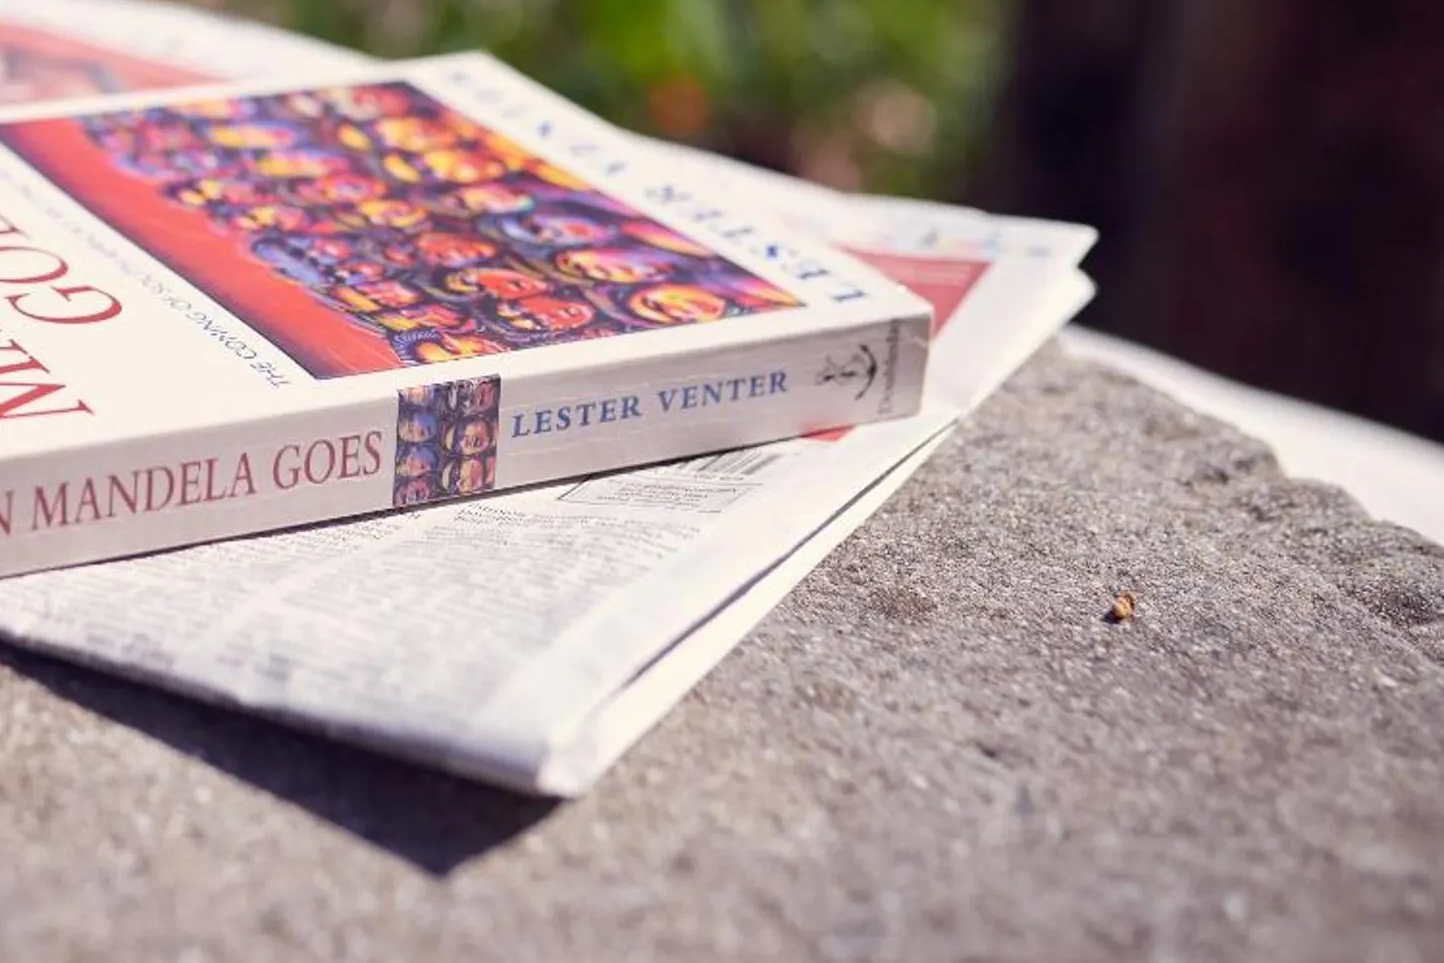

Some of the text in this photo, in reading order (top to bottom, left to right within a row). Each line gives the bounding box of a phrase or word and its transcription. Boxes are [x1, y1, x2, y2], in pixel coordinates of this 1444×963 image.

[185, 311, 258, 361] COMING
[248, 360, 291, 388] THE
[512, 370, 789, 438] LESTER VENTER
[31, 451, 258, 531] MANDELA
[272, 430, 383, 491] GOES
